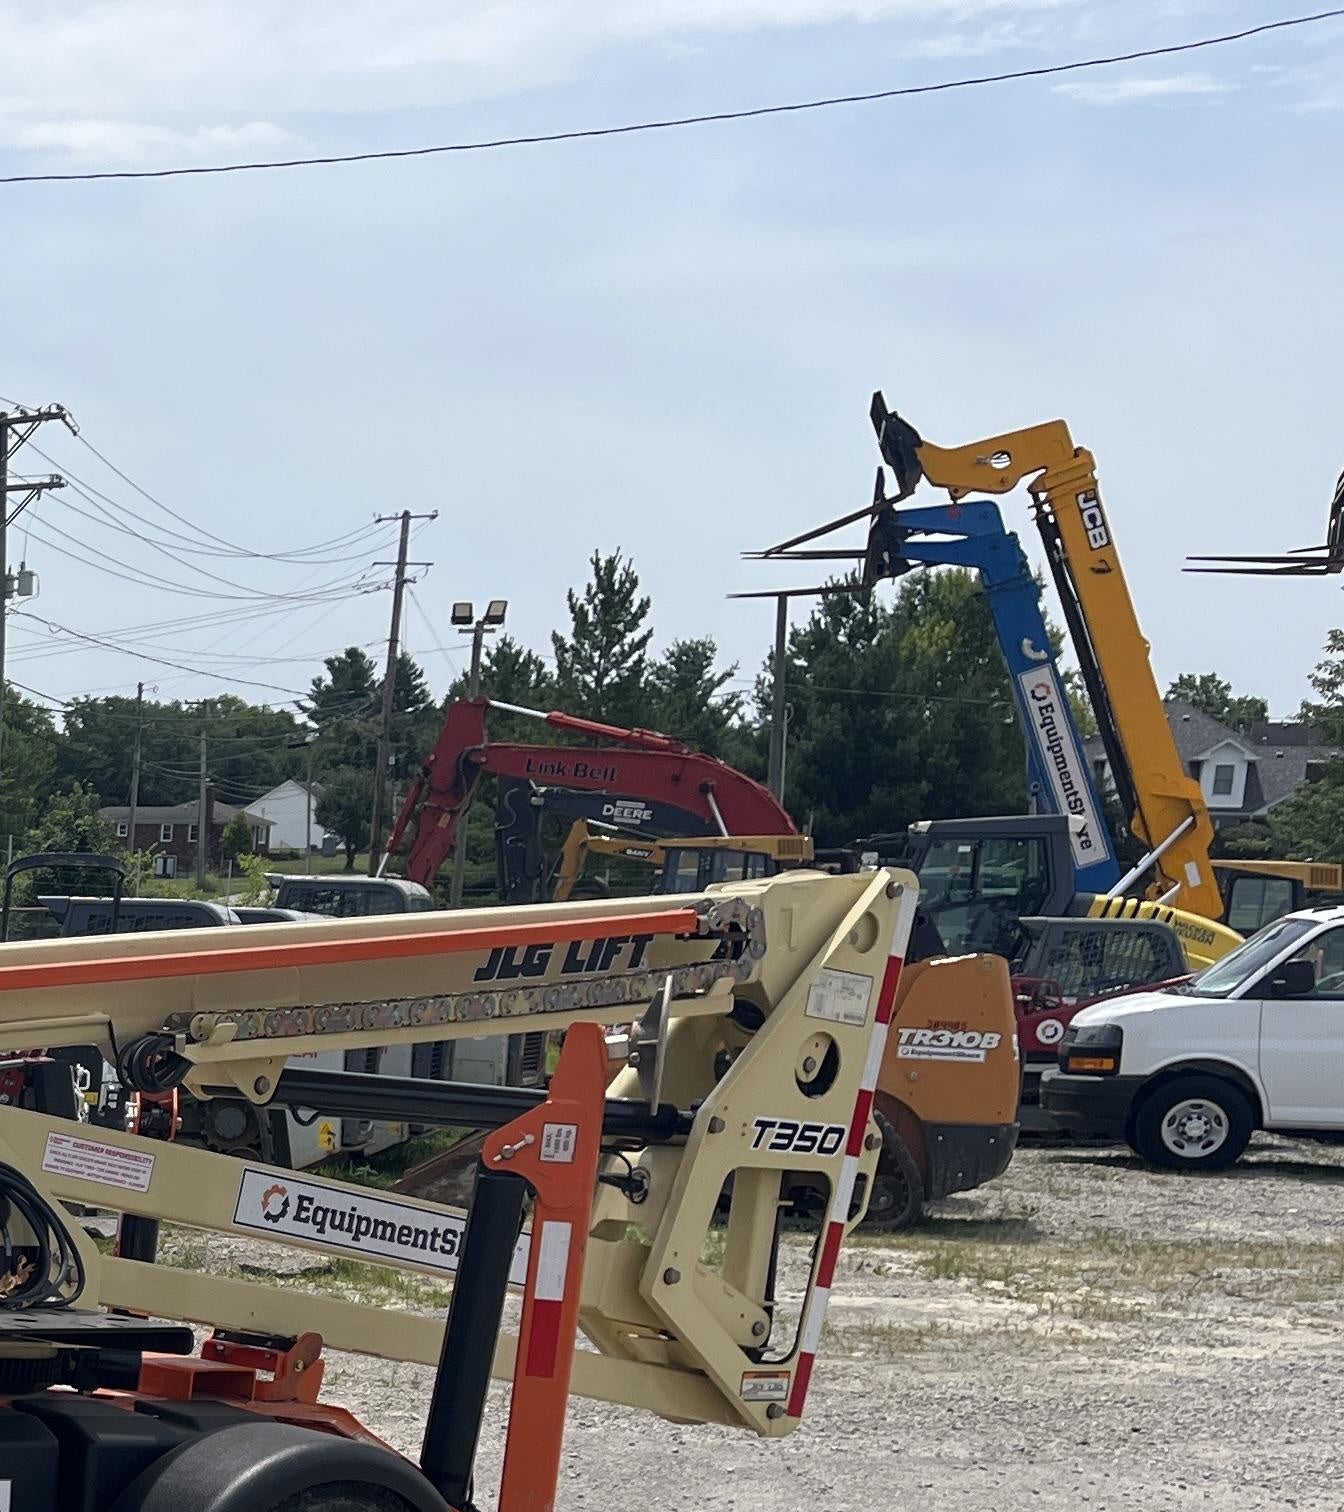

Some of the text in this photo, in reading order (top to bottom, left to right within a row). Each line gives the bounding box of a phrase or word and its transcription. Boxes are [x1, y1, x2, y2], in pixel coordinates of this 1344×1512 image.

[1077, 494, 1109, 549] JCB
[526, 758, 616, 781] Link-Bell
[602, 804, 653, 820] DEERE
[474, 934, 654, 981] JLG LIFT
[898, 1027, 1002, 1050] TR310B
[752, 1119, 846, 1156] T350
[293, 1194, 465, 1257] EquipmentS
